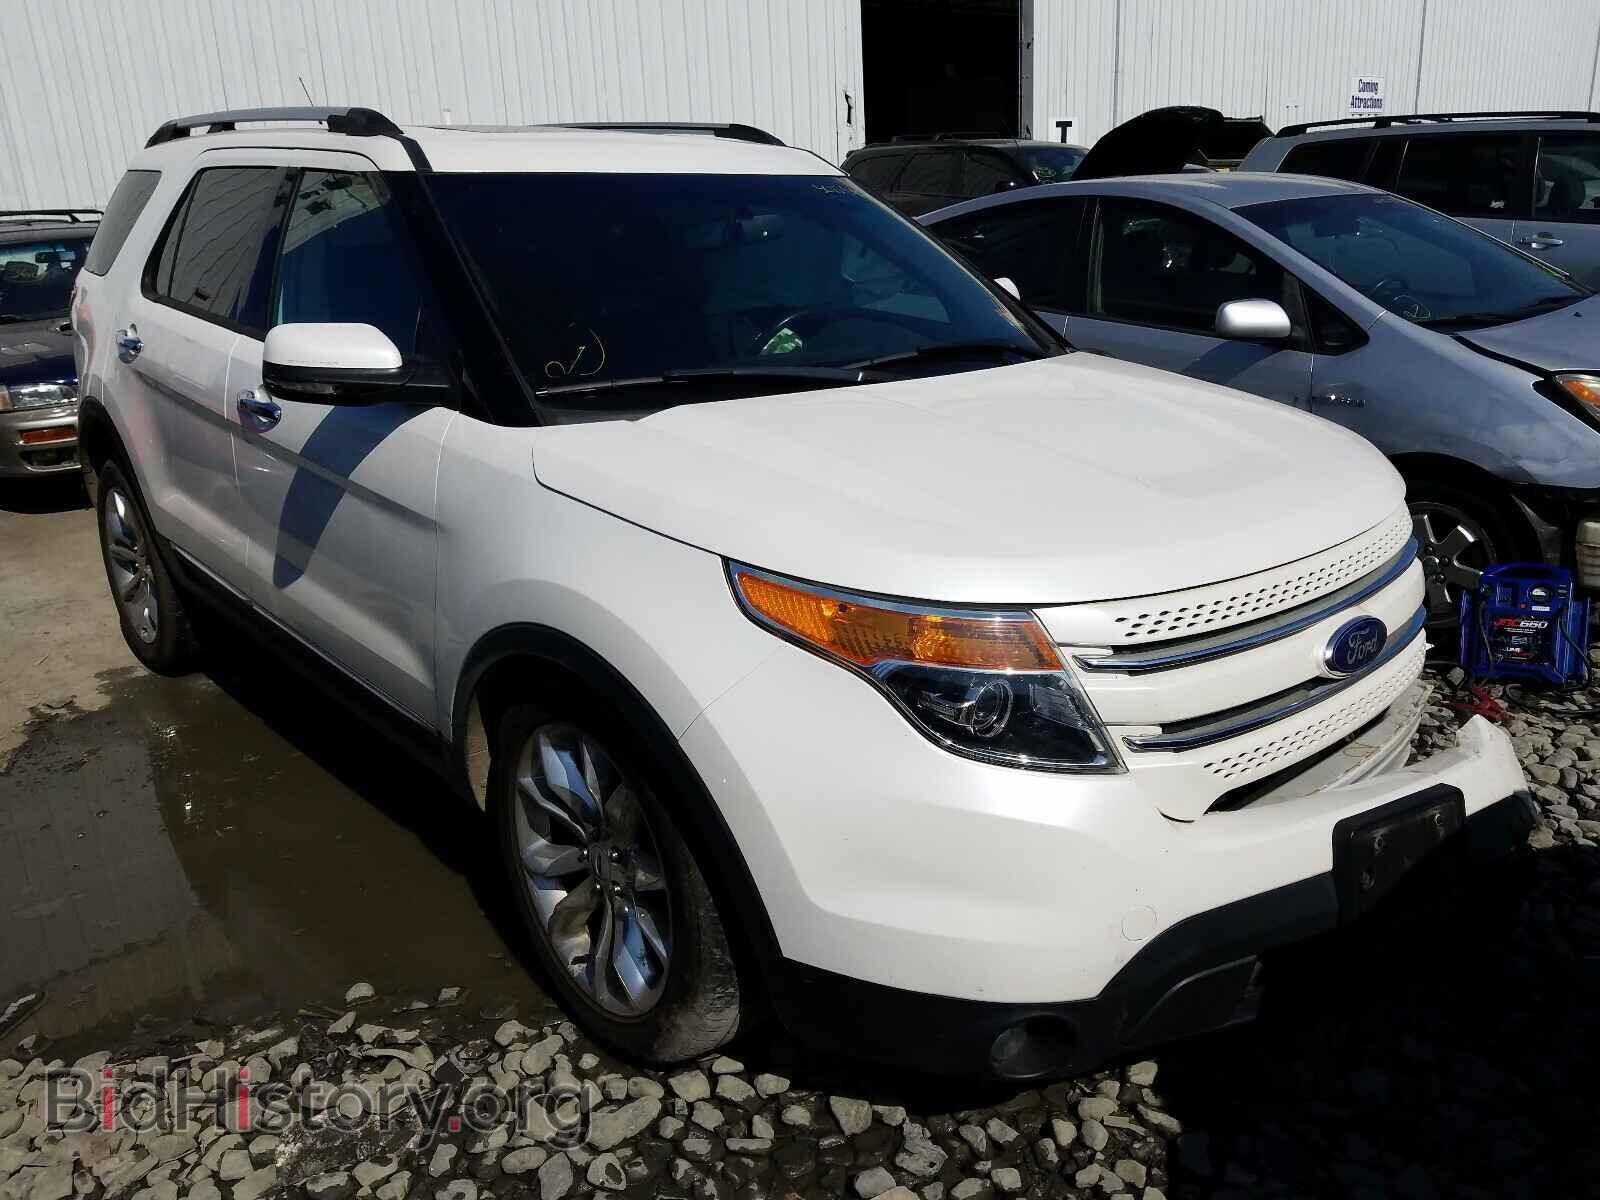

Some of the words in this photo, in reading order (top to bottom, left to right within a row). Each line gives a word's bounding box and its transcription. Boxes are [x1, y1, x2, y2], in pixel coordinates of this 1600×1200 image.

[1358, 78, 1379, 95] Coming
[1351, 95, 1383, 109] Attractions
[1346, 627, 1378, 664] Ford
